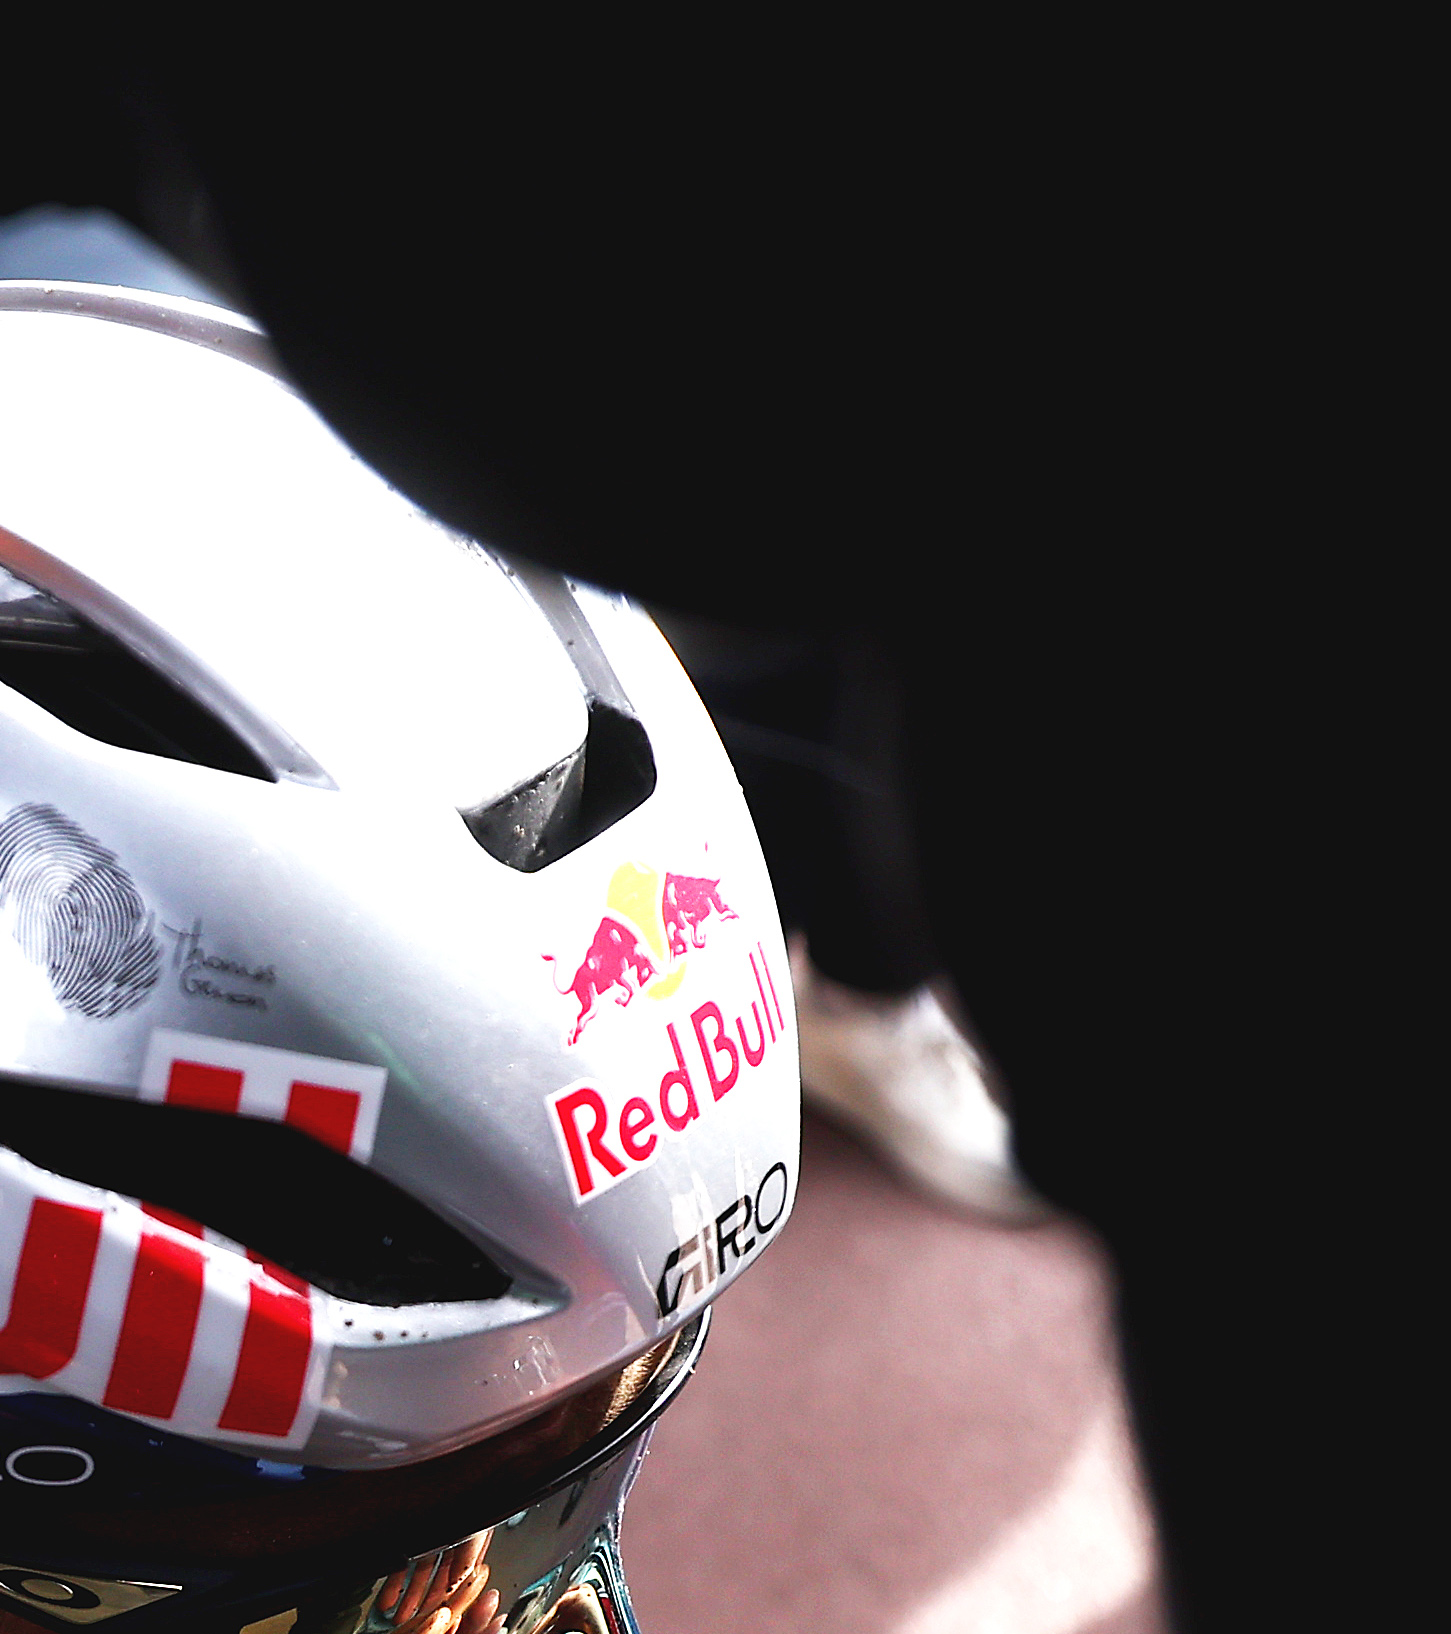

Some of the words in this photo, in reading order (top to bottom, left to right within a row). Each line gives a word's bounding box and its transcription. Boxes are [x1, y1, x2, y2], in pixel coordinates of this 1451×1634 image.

[555, 1022, 700, 1197] Red
[690, 940, 785, 1102] Bull
[657, 1162, 788, 1319] GIRO
